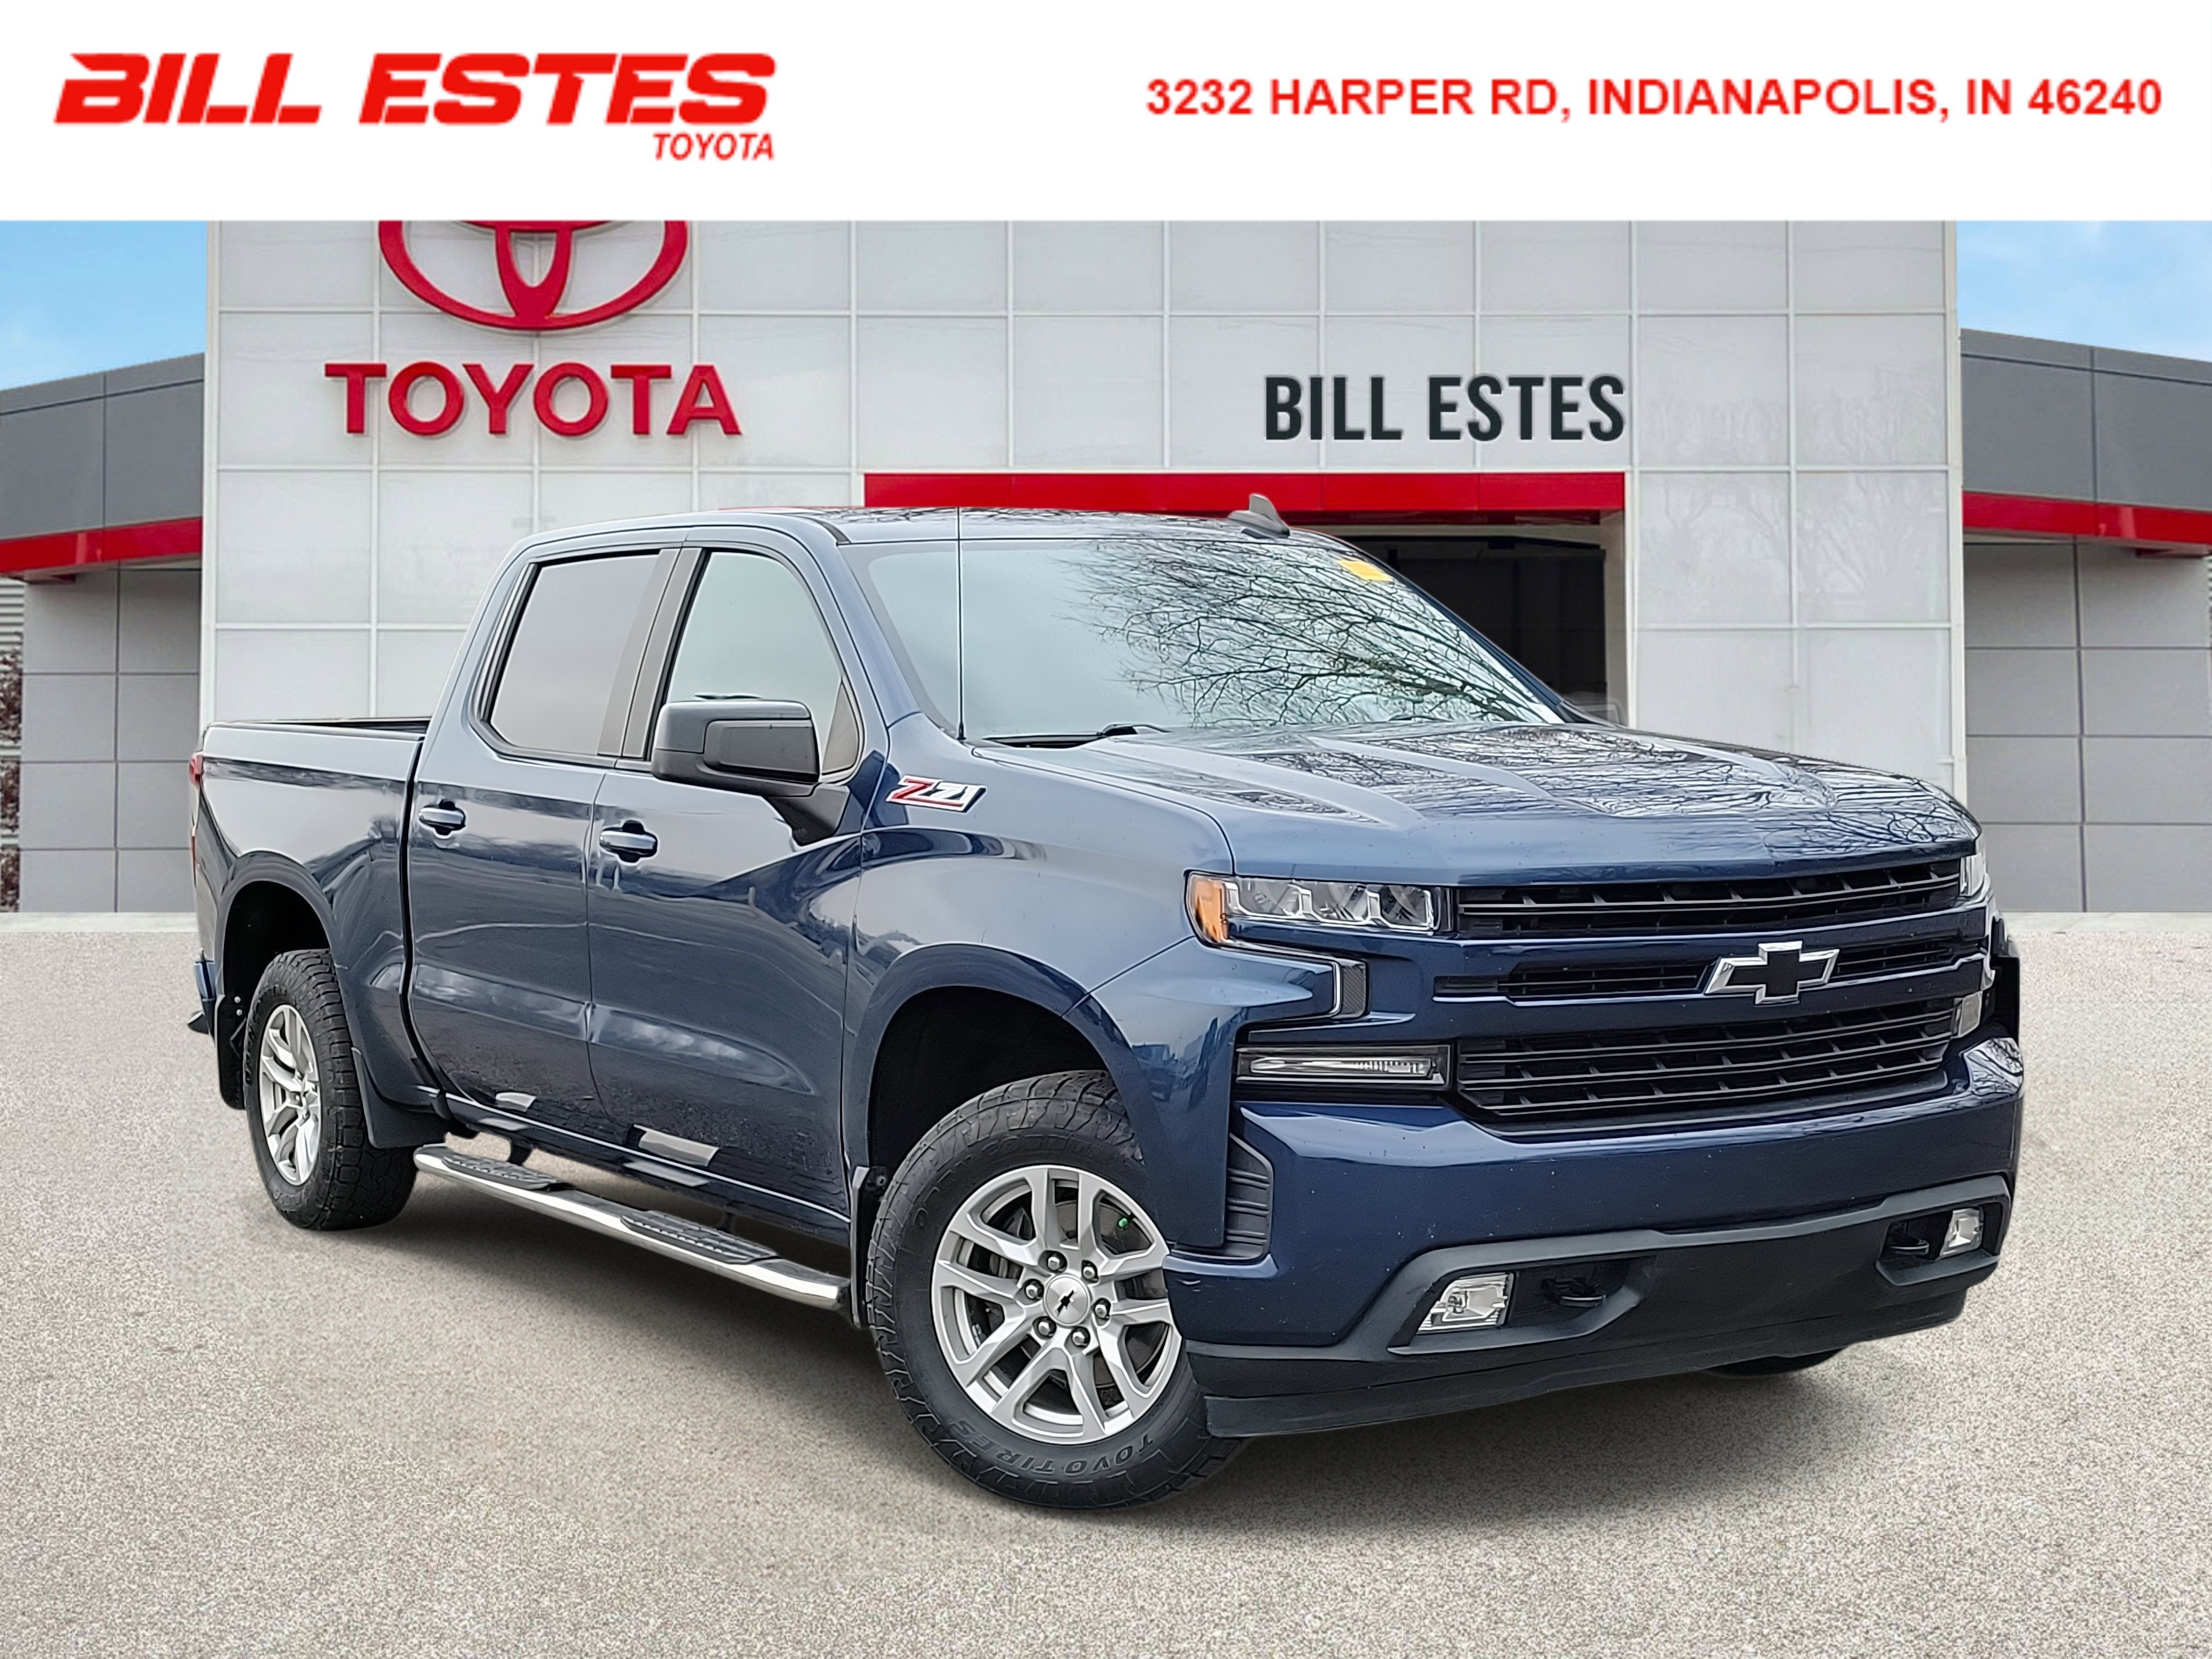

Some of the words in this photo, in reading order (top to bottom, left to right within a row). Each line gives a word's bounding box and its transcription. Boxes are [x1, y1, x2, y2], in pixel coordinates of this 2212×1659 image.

[324, 360, 741, 437] TOYOTA
[1265, 376, 1402, 440] BILL
[1428, 375, 1624, 442] ESTES
[886, 775, 986, 812] Z71
[949, 1419, 1056, 1475] TIRES
[1064, 1433, 1154, 1477] TOYO
